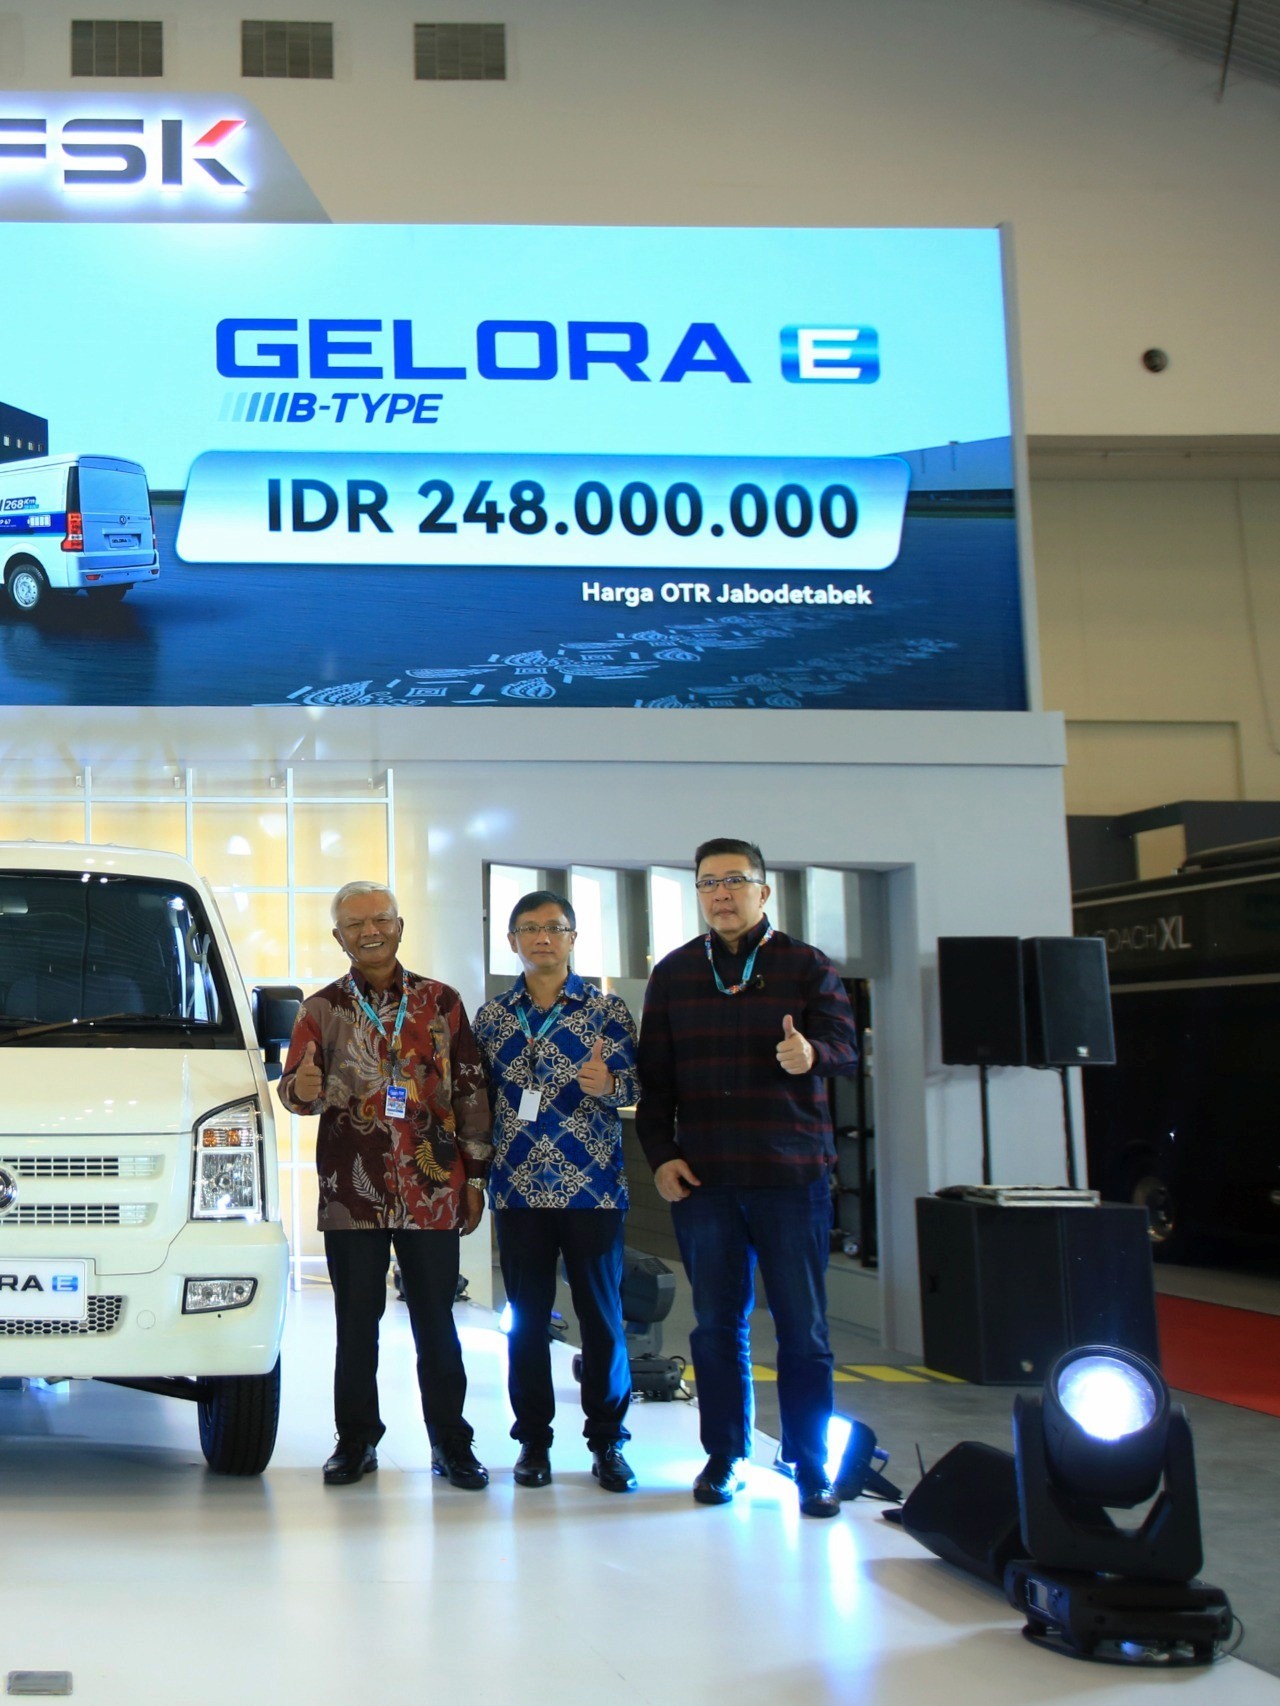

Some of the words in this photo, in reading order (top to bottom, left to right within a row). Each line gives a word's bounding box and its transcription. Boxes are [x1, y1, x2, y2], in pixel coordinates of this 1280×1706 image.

[215, 317, 752, 384] GELORA
[286, 391, 444, 425] B-TYPE
[5, 500, 24, 510] 268
[267, 478, 394, 534] IDR
[417, 480, 859, 540] 248.000.000
[582, 581, 654, 607] Harga
[661, 583, 712, 604] OTR
[716, 582, 873, 606] Jabodetabek
